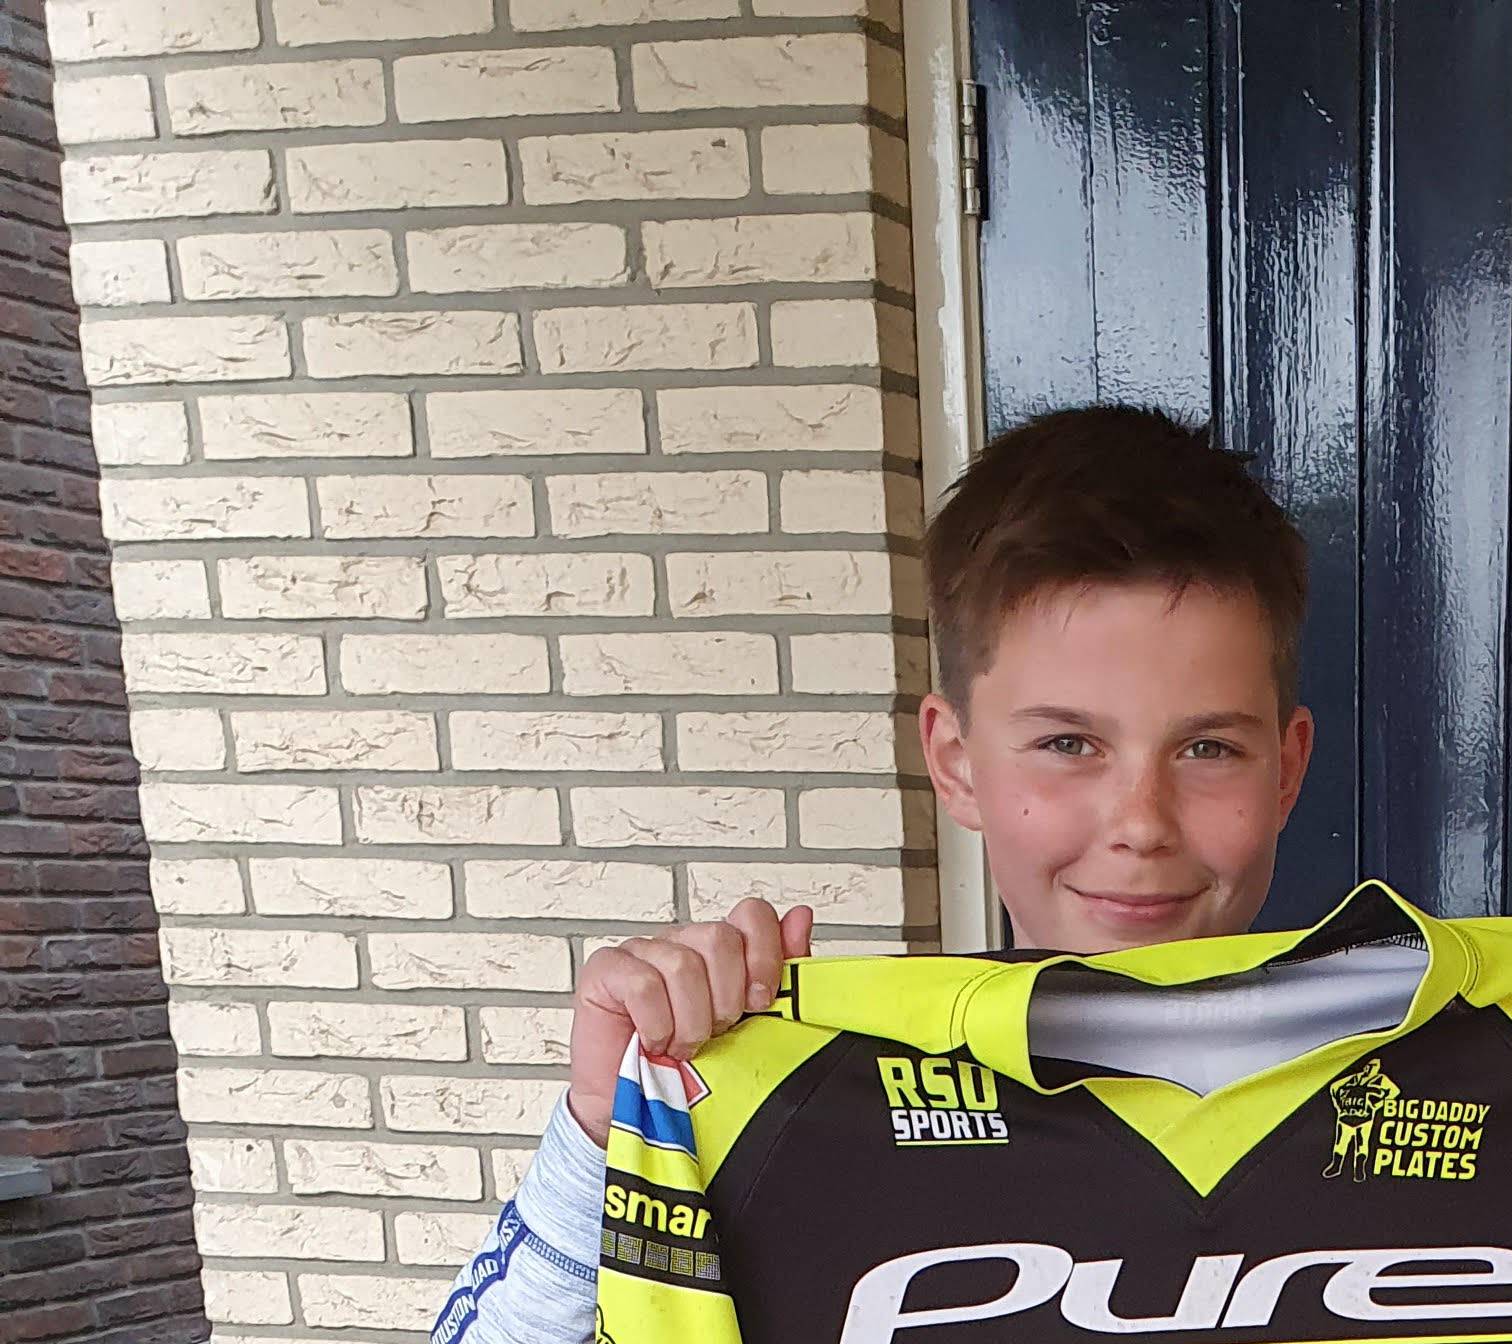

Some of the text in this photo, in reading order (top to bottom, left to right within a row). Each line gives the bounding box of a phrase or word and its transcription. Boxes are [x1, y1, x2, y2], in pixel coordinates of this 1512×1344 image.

[877, 1057, 998, 1111] RSD
[891, 1109, 1008, 1140] SPORTS
[1383, 1099, 1419, 1119] BIG
[1421, 1100, 1491, 1125] DADDY
[1379, 1120, 1483, 1150] CUSTOM
[1373, 1148, 1476, 1180] PLATES
